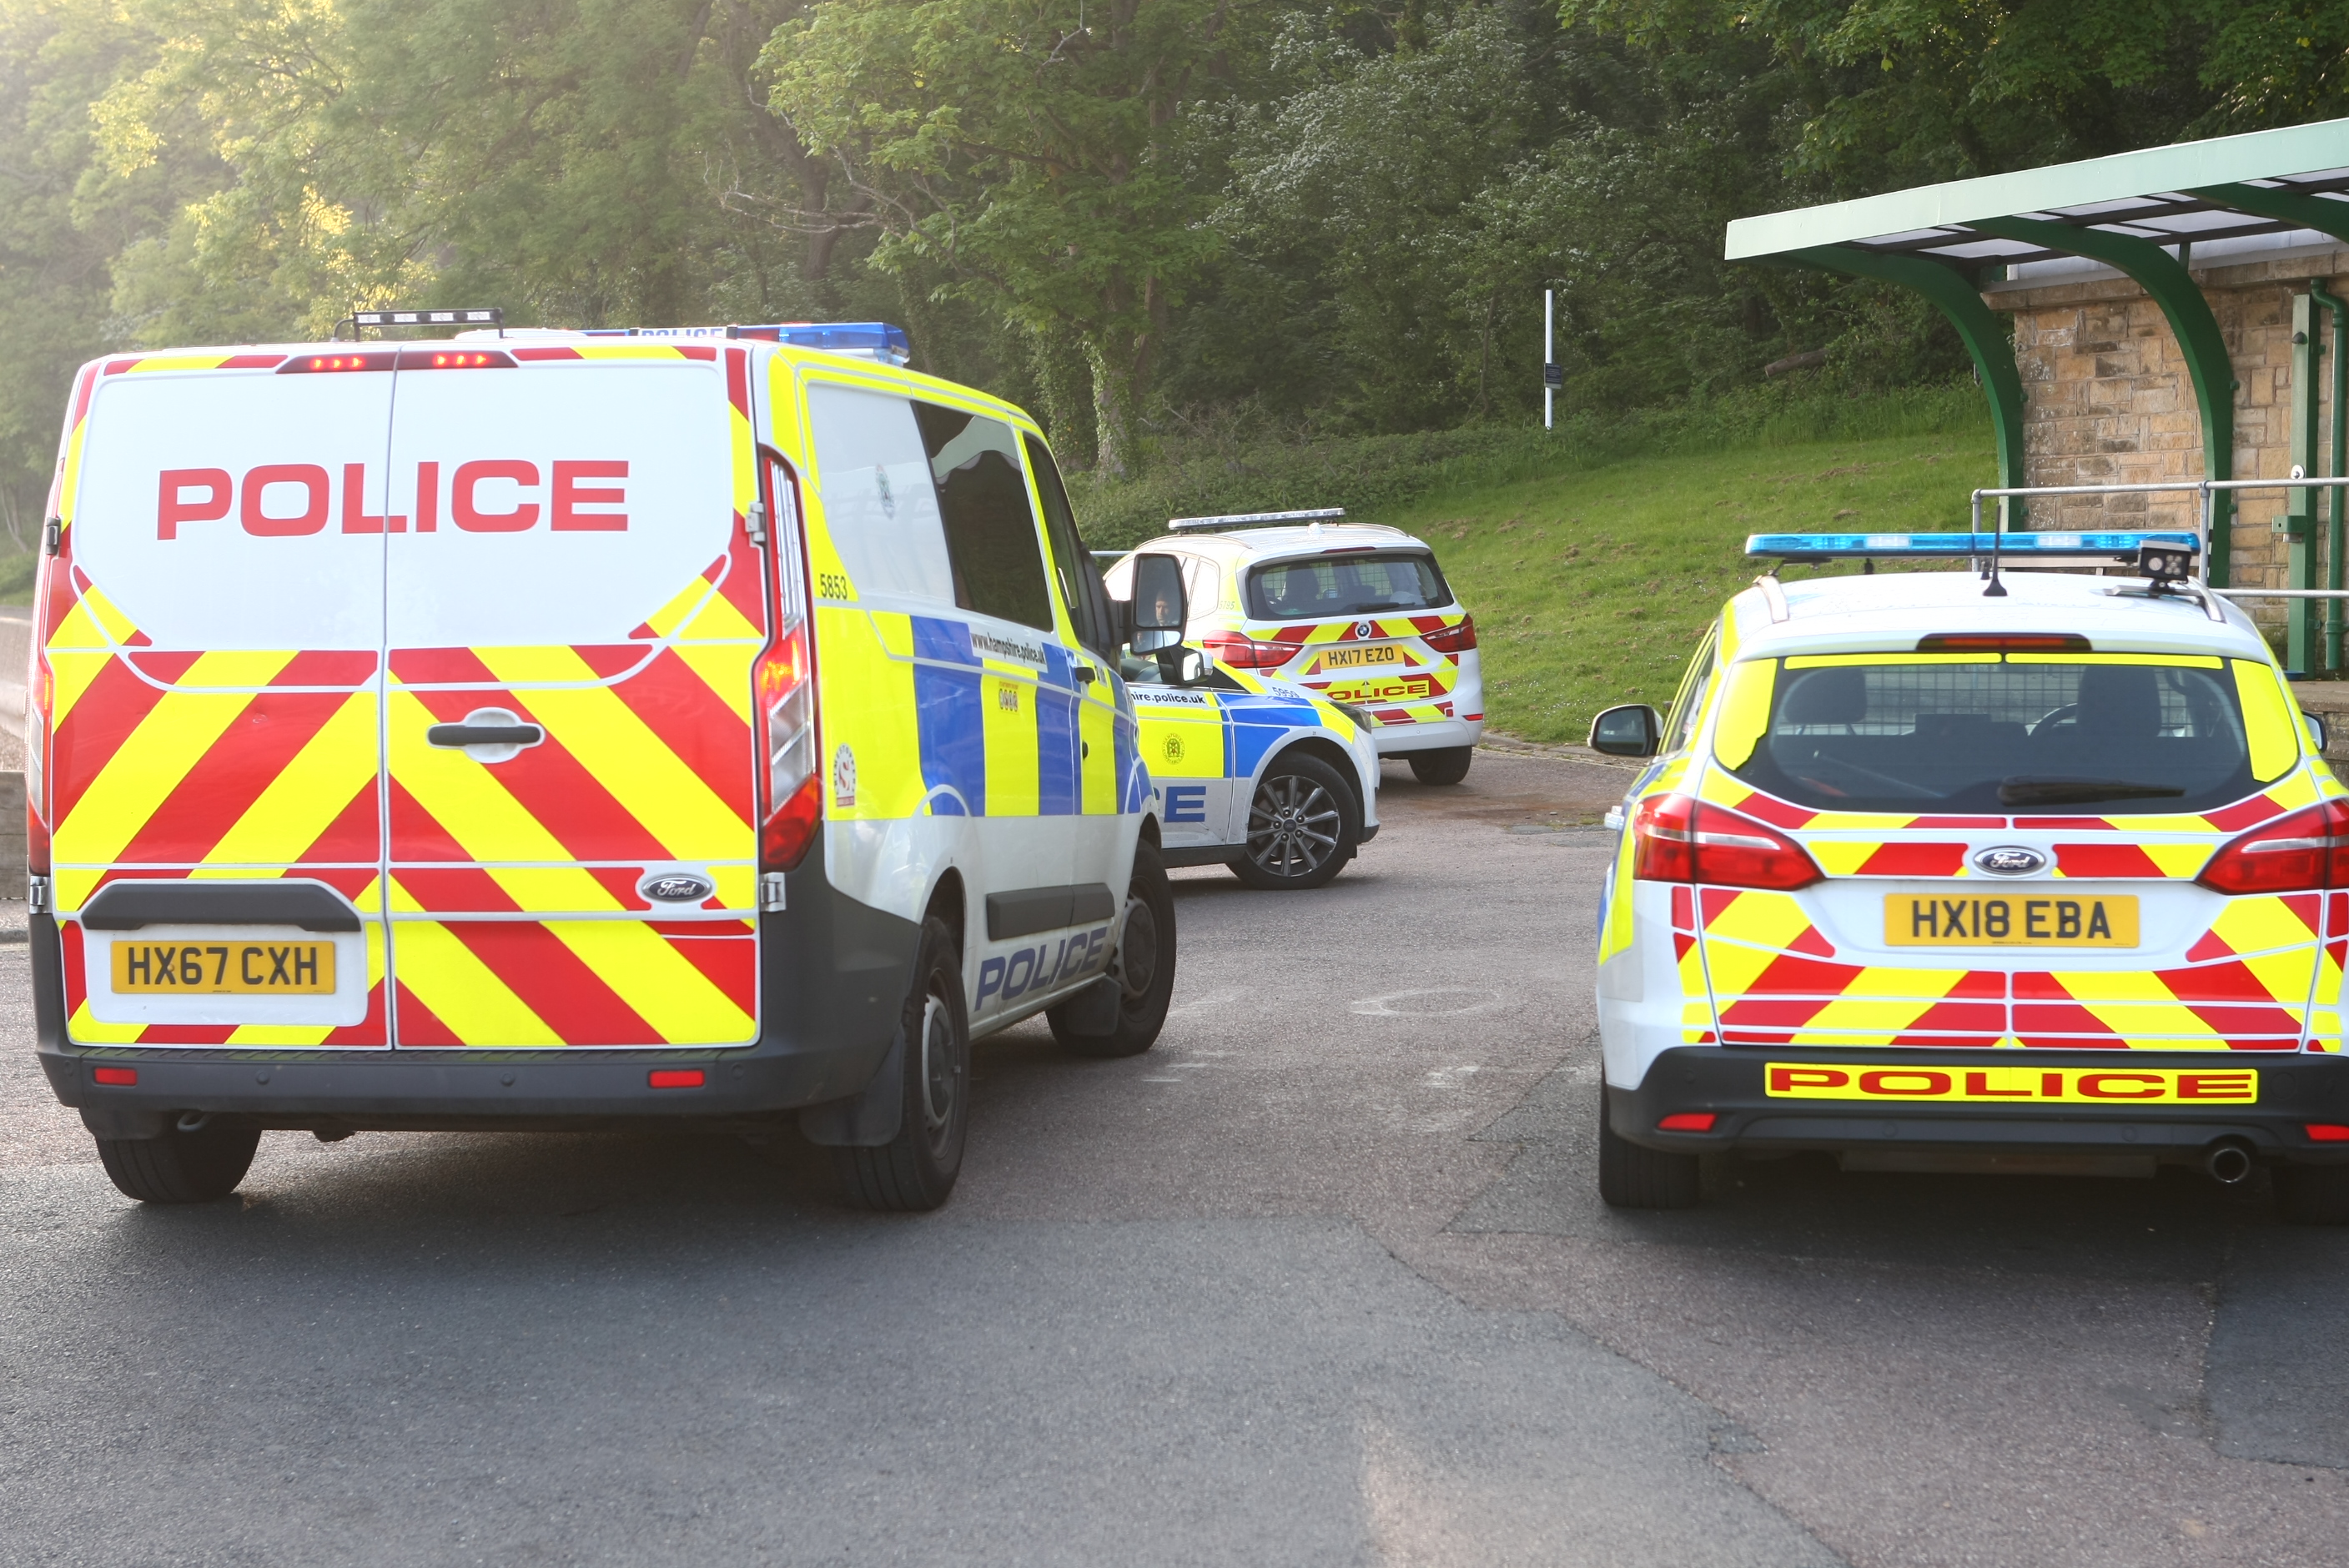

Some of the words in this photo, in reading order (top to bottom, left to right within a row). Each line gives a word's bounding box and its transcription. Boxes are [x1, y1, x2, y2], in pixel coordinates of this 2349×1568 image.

[157, 460, 629, 540] POLICE
[820, 573, 848, 600] 5853
[1219, 601, 1235, 610] 5795
[1328, 650, 1361, 666] HX17
[1365, 646, 1394, 662] EZO
[1272, 686, 1300, 697] 5959
[1327, 684, 1426, 700] OLICE
[1989, 852, 2031, 868] Ford
[656, 880, 697, 896] Ford
[1912, 900, 2009, 937] HX18
[2025, 901, 2112, 939] EBA
[128, 947, 229, 985] HX67
[241, 947, 318, 985] CXH
[974, 926, 1108, 1012] POLICE
[1770, 1068, 2252, 1098] POLICE
